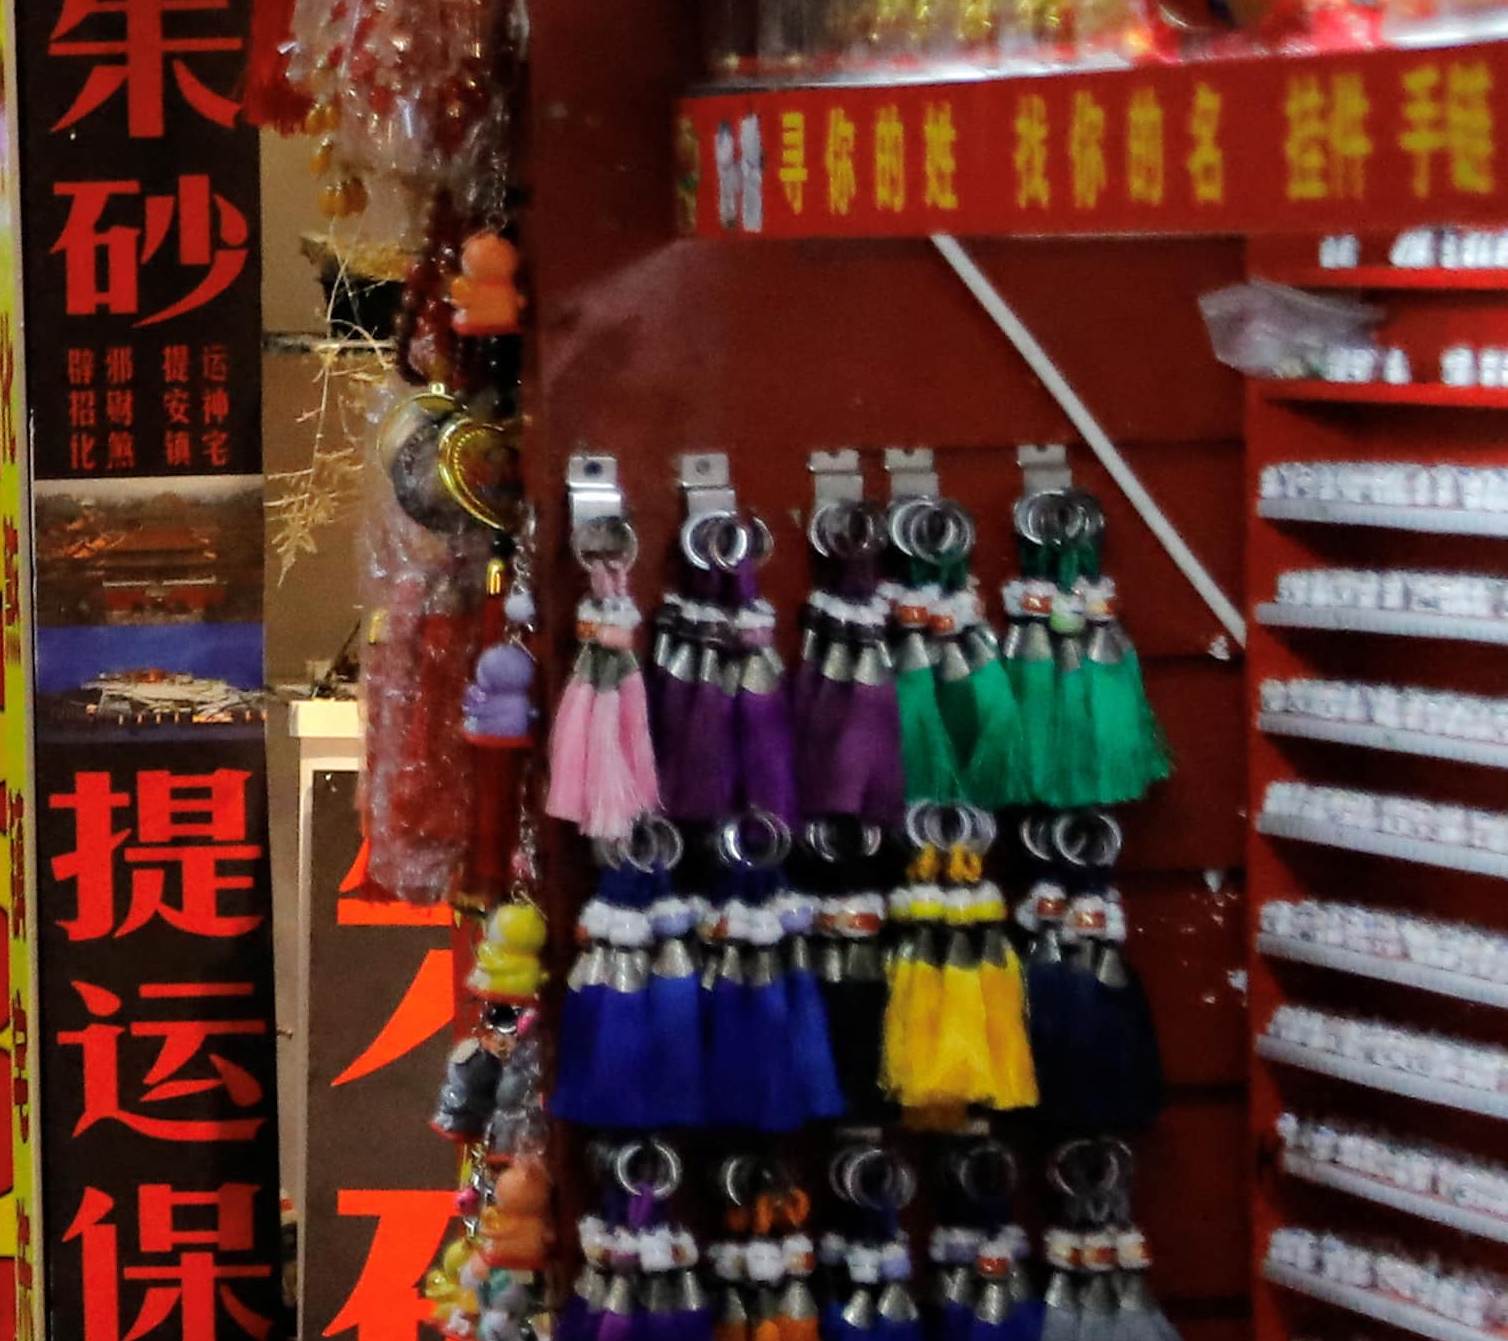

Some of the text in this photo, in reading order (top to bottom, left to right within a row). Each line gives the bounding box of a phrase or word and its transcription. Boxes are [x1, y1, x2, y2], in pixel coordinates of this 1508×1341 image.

[779, 99, 959, 215] 寻你的姓
[1013, 80, 1225, 210] 找你的名
